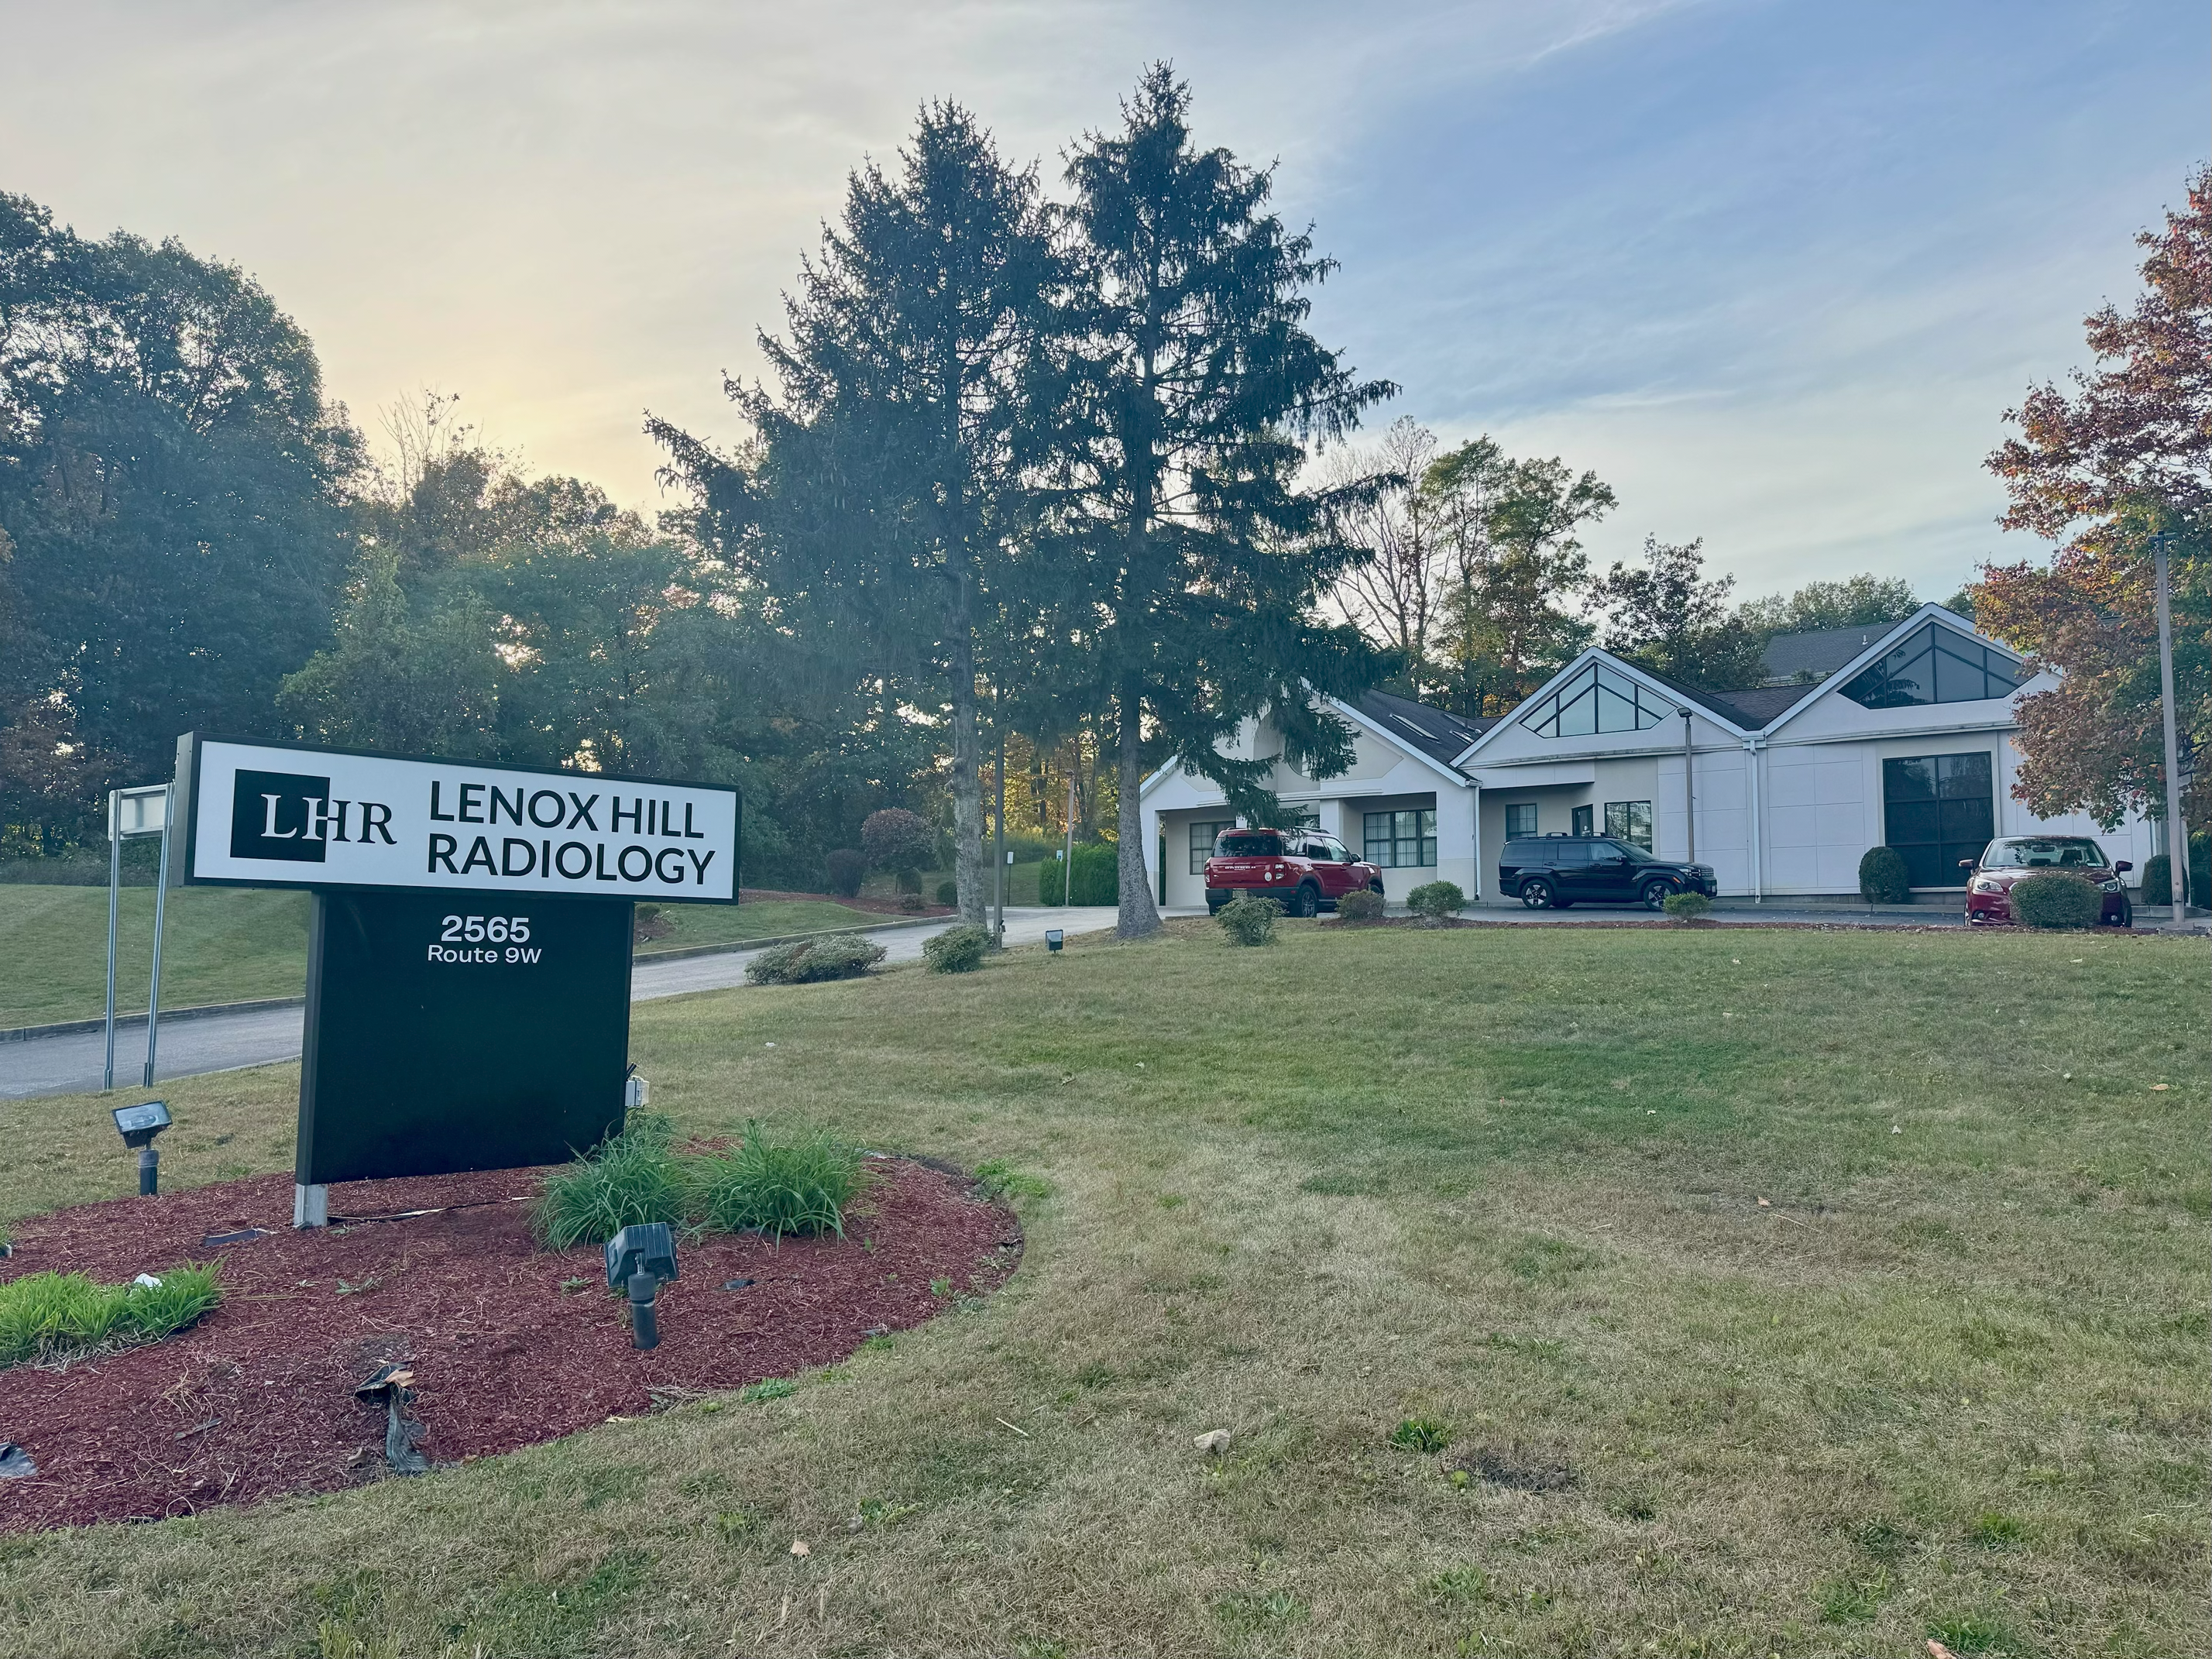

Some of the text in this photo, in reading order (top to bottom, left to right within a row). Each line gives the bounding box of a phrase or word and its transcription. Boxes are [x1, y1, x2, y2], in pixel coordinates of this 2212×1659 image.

[260, 794, 398, 845] LHR
[431, 781, 704, 839] LENOX HILL
[428, 833, 716, 885] RADIOLOGY
[428, 945, 542, 963] Route 9W
[441, 915, 531, 943] 2565
